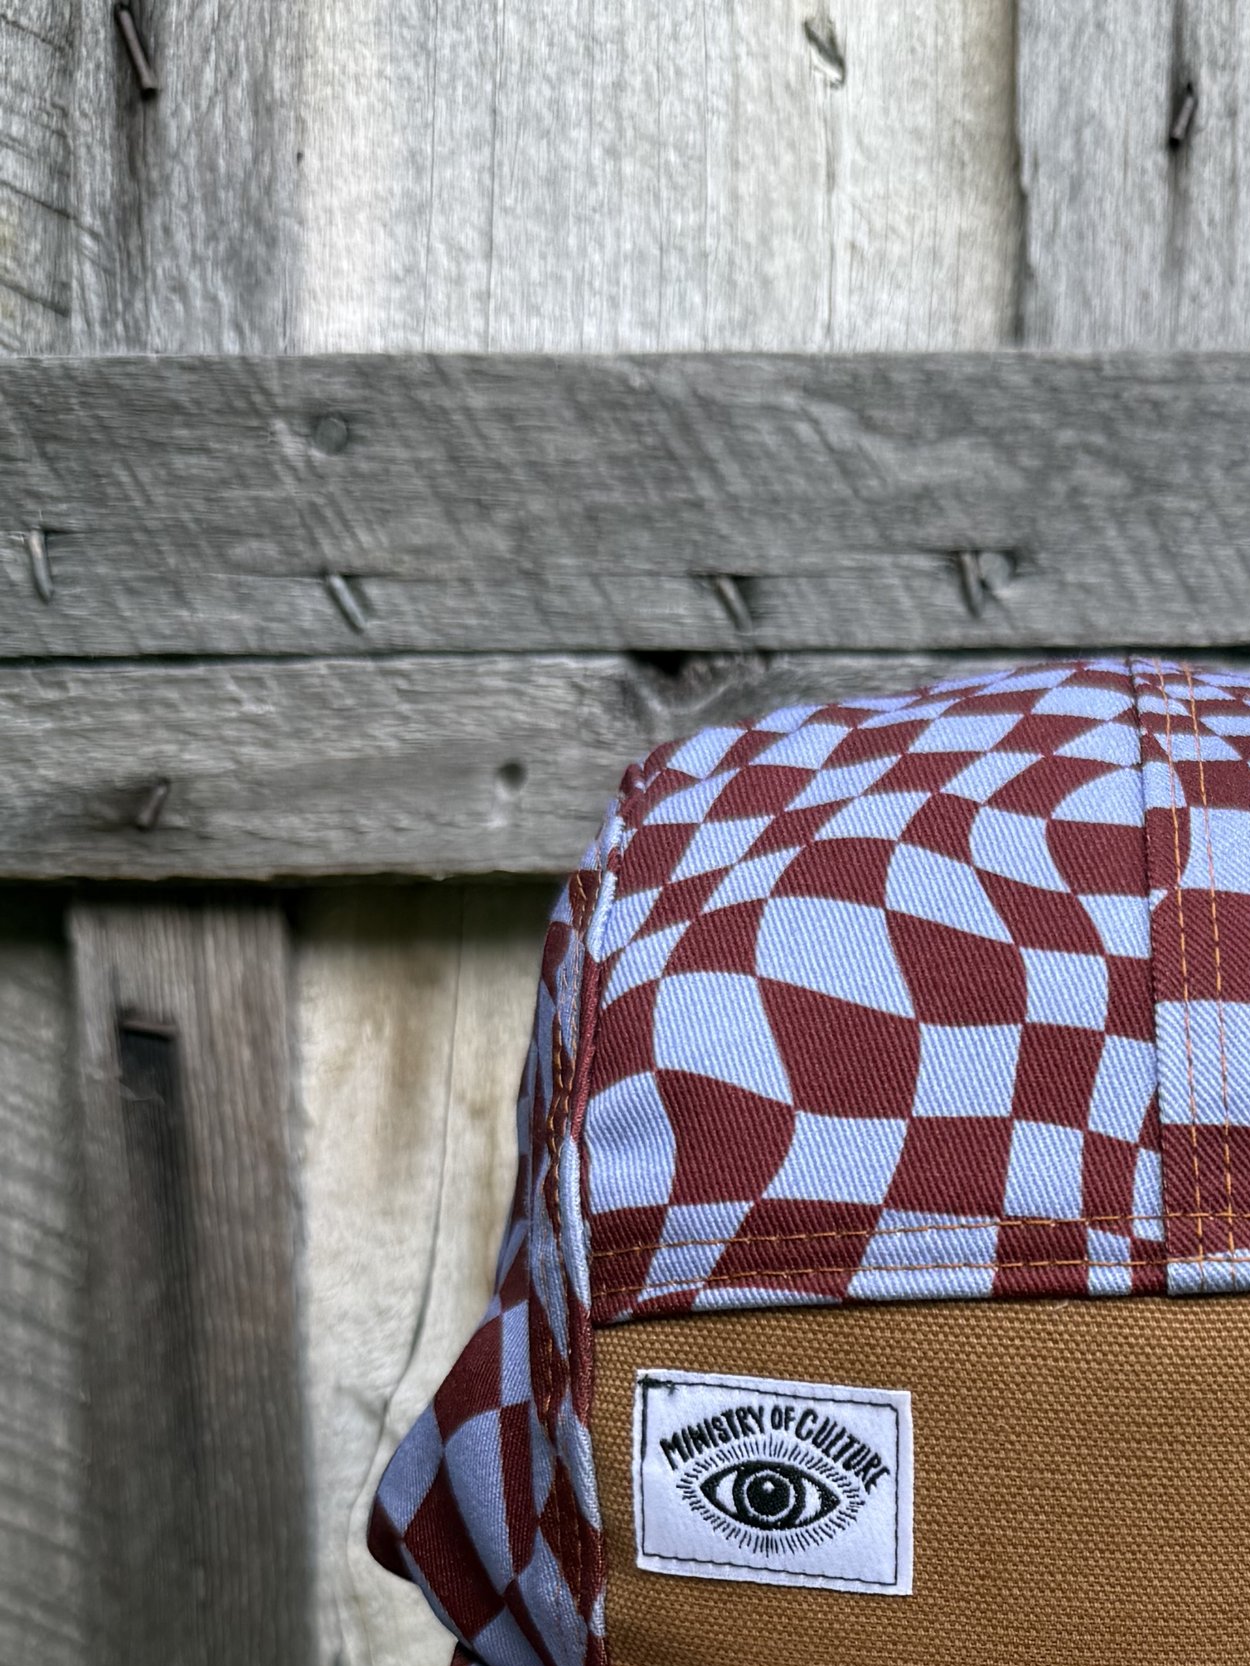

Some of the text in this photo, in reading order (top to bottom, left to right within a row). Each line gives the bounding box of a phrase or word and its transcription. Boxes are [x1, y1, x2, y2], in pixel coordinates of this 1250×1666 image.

[660, 1404, 891, 1495] MINISTRY OF CULTURE
